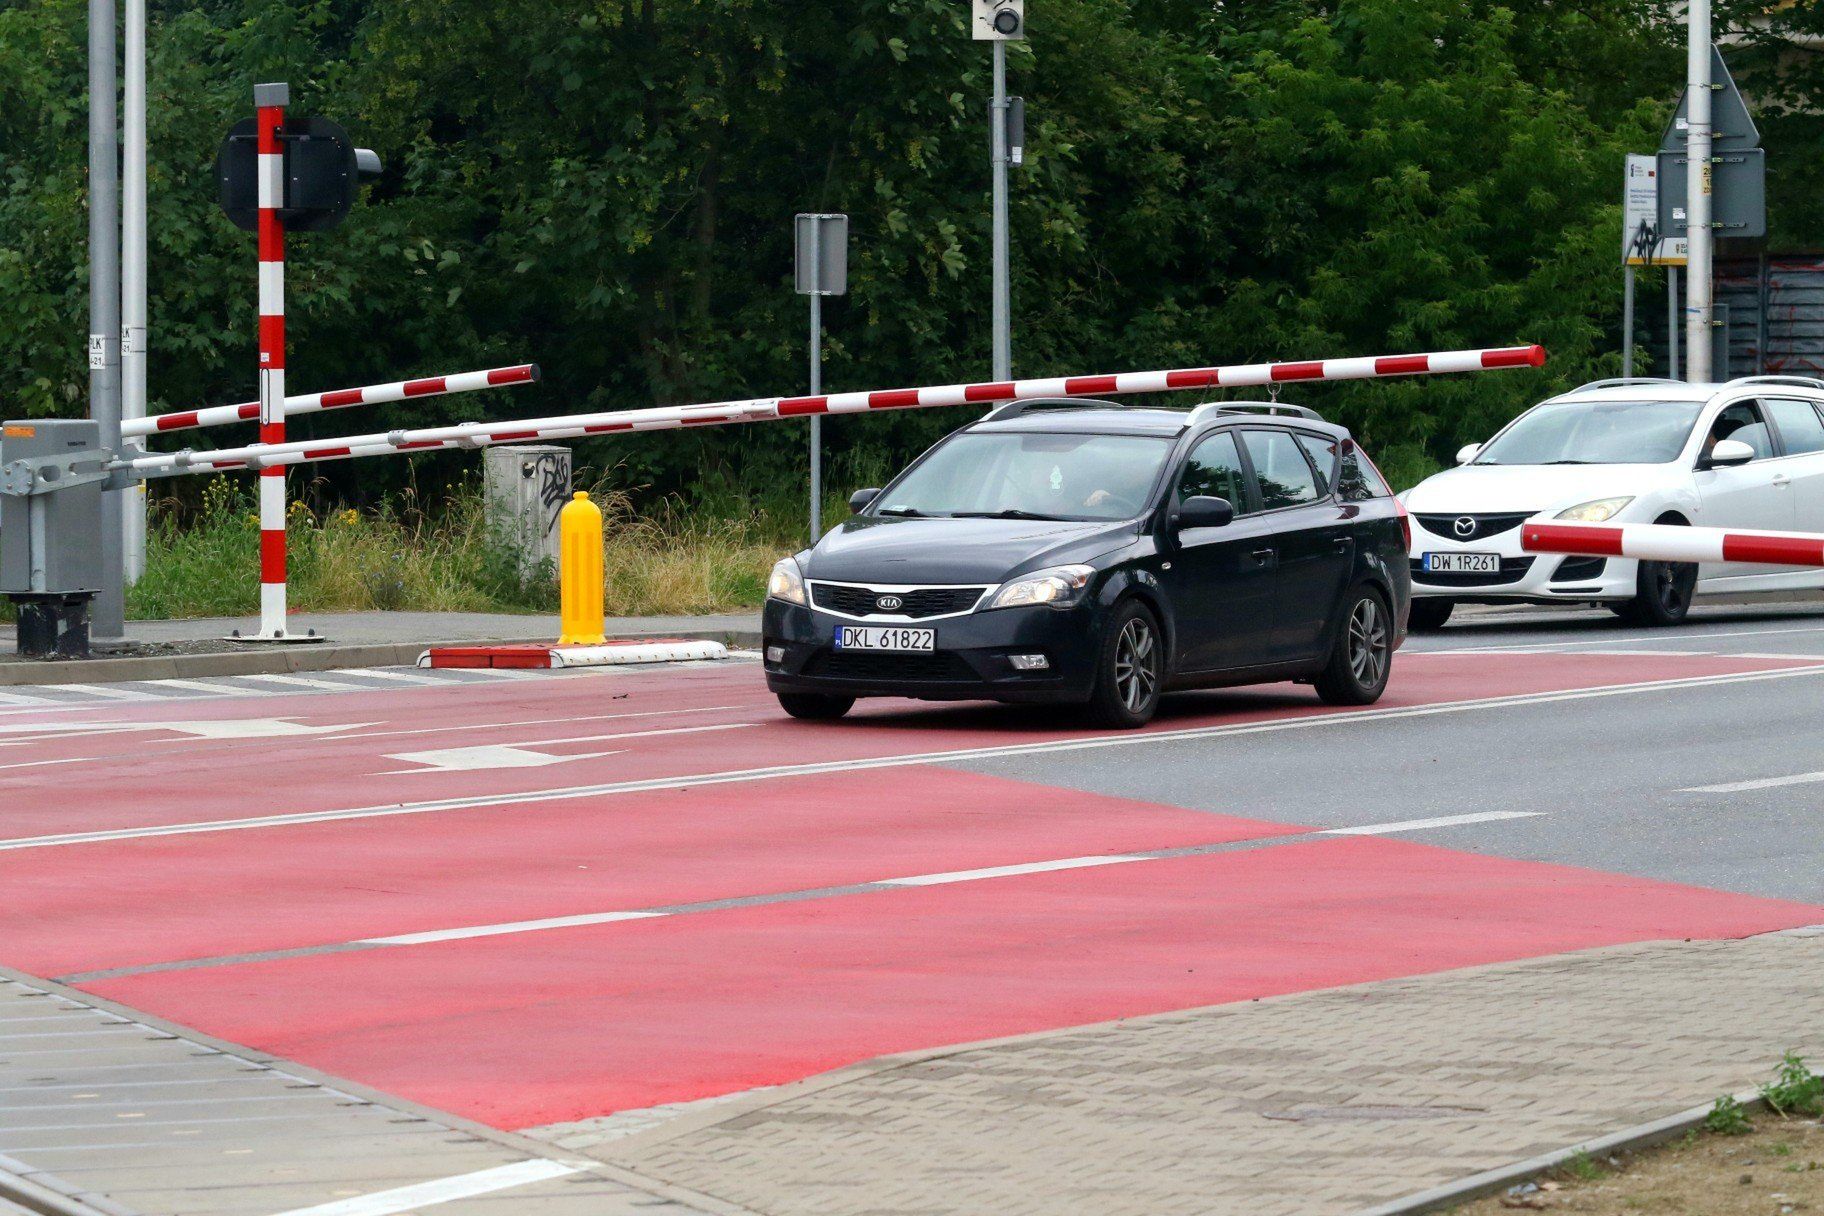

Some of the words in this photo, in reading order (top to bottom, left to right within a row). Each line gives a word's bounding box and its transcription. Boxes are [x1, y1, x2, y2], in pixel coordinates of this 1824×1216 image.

[1431, 555, 1451, 570] DW
[1457, 555, 1496, 571] 1R261
[880, 599, 898, 607] KIA
[843, 628, 874, 648] DKL
[879, 629, 932, 650] 61822
